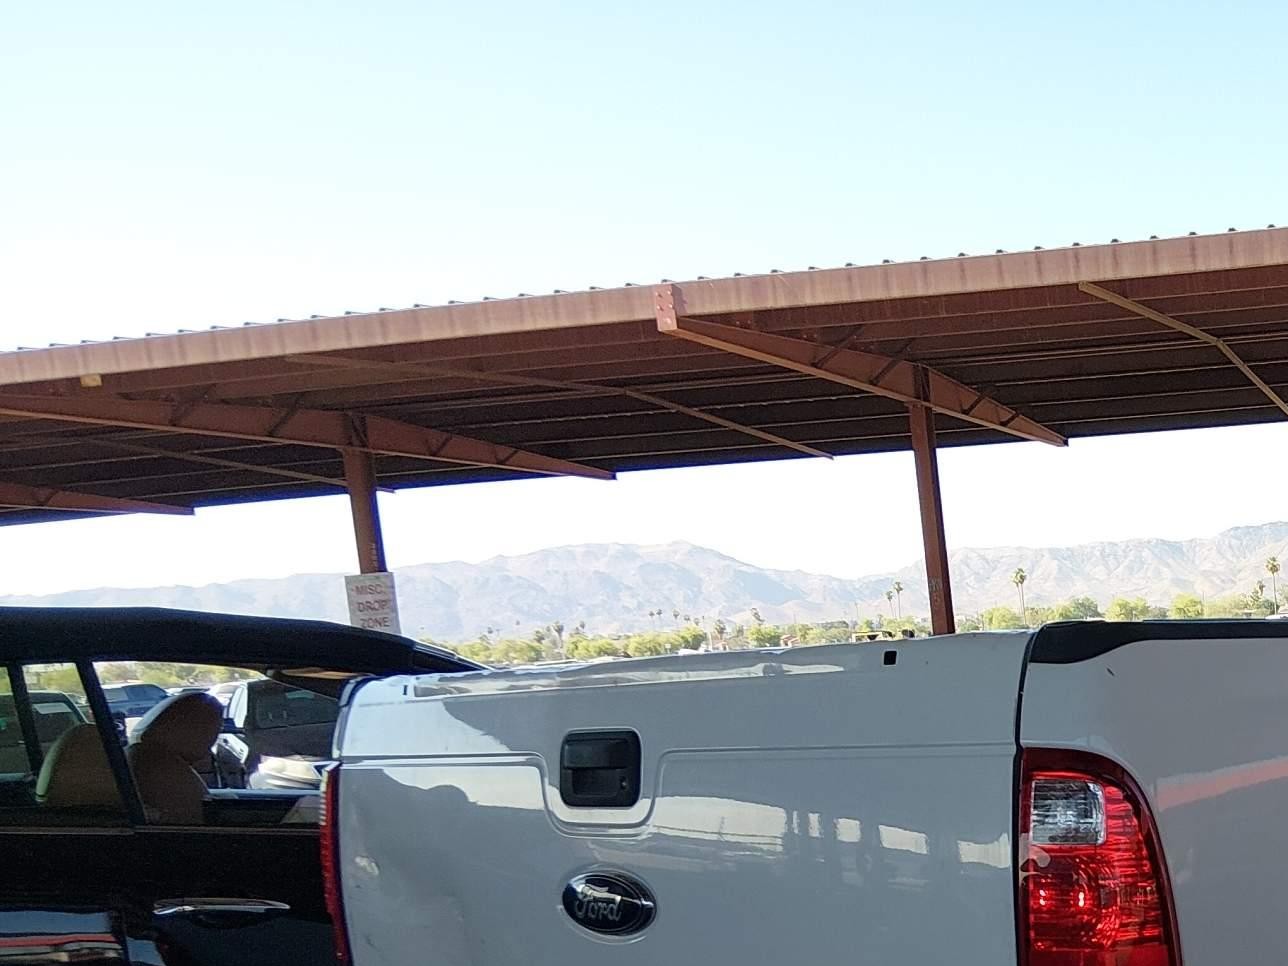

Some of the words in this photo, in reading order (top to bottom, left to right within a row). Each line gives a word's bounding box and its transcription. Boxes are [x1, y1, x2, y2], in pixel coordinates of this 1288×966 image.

[357, 599, 388, 612] DROP
[360, 616, 390, 629] ZONE
[575, 884, 622, 921] Ford
